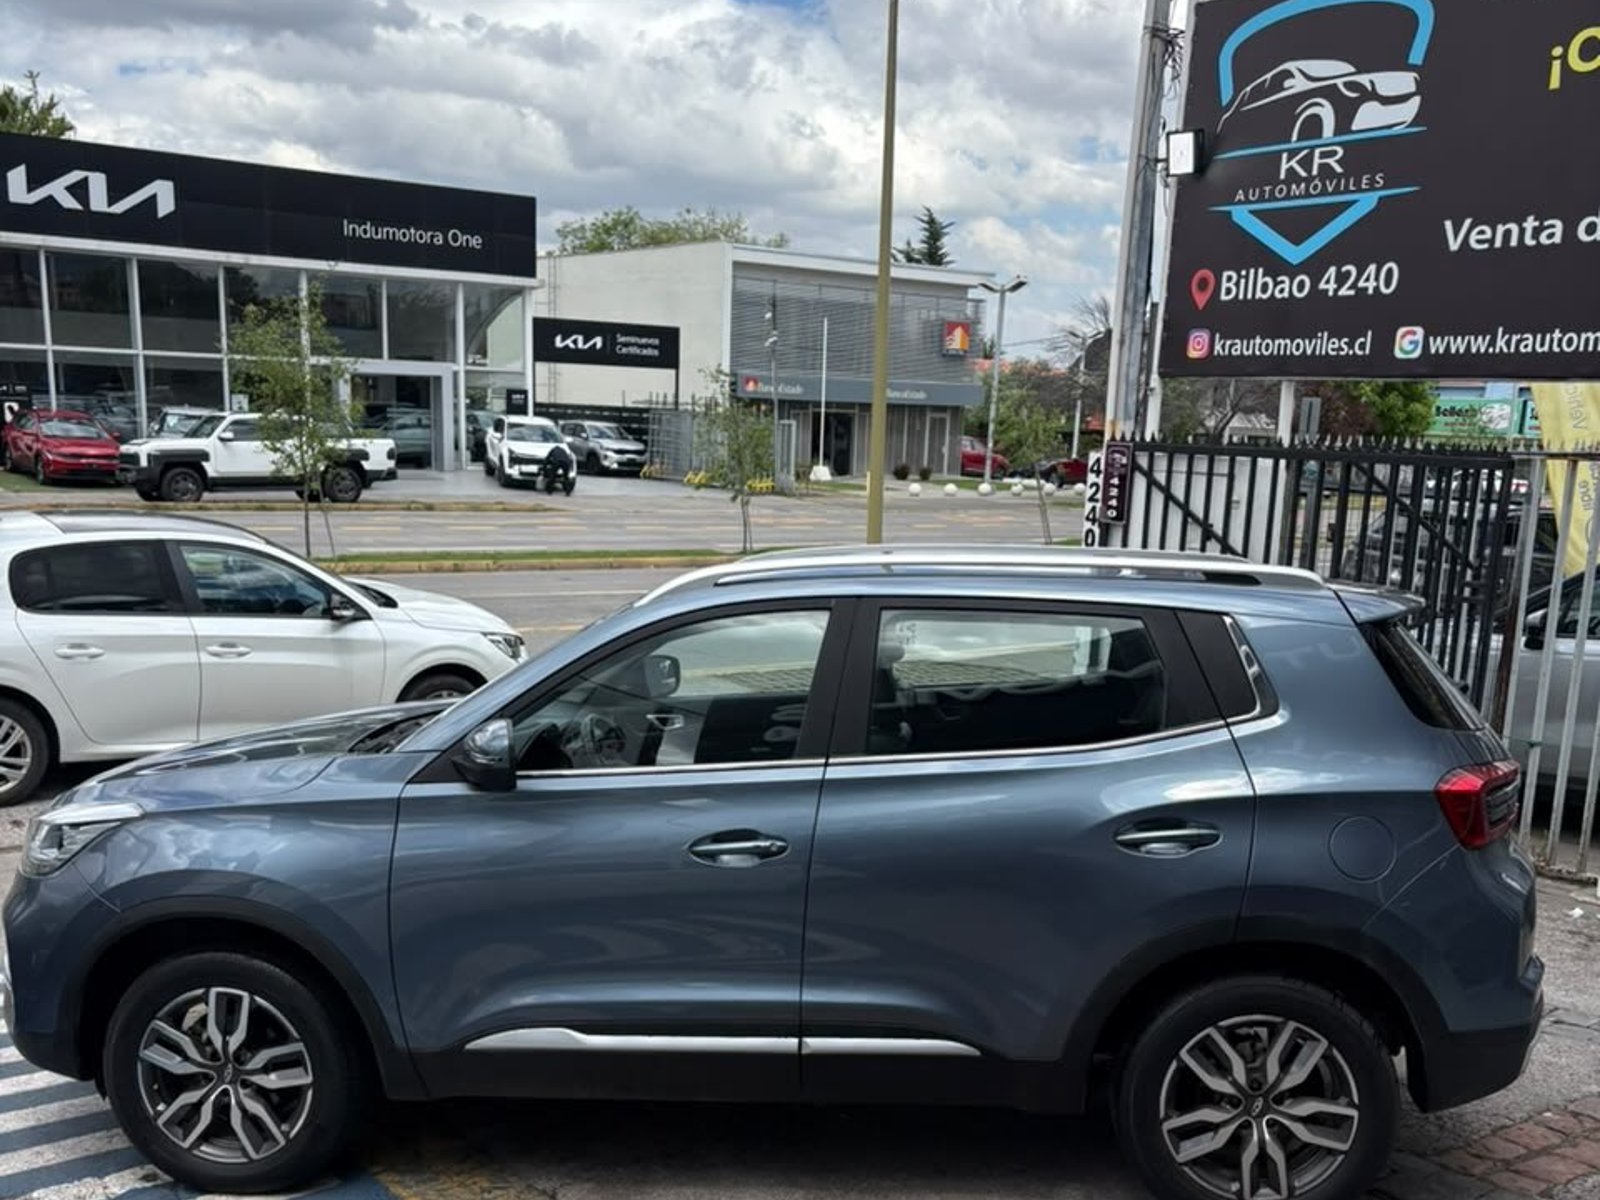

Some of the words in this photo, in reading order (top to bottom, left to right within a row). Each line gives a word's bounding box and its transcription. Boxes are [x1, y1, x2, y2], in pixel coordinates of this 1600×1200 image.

[1279, 145, 1345, 180] KR
[6, 163, 176, 219] KIA
[1234, 172, 1385, 202] AUTOMÓVILES
[342, 218, 444, 246] Indumotora
[447, 228, 483, 249] One
[1443, 214, 1564, 252] Venta
[1219, 267, 1311, 301] Bilbao
[1318, 261, 1399, 297] 4240
[554, 334, 603, 350] KIA
[1213, 329, 1372, 356] krautomoviles.cl
[1428, 326, 1600, 354] www.krautom
[1085, 456, 1102, 547] 4240
[1106, 477, 1119, 518] 4240
